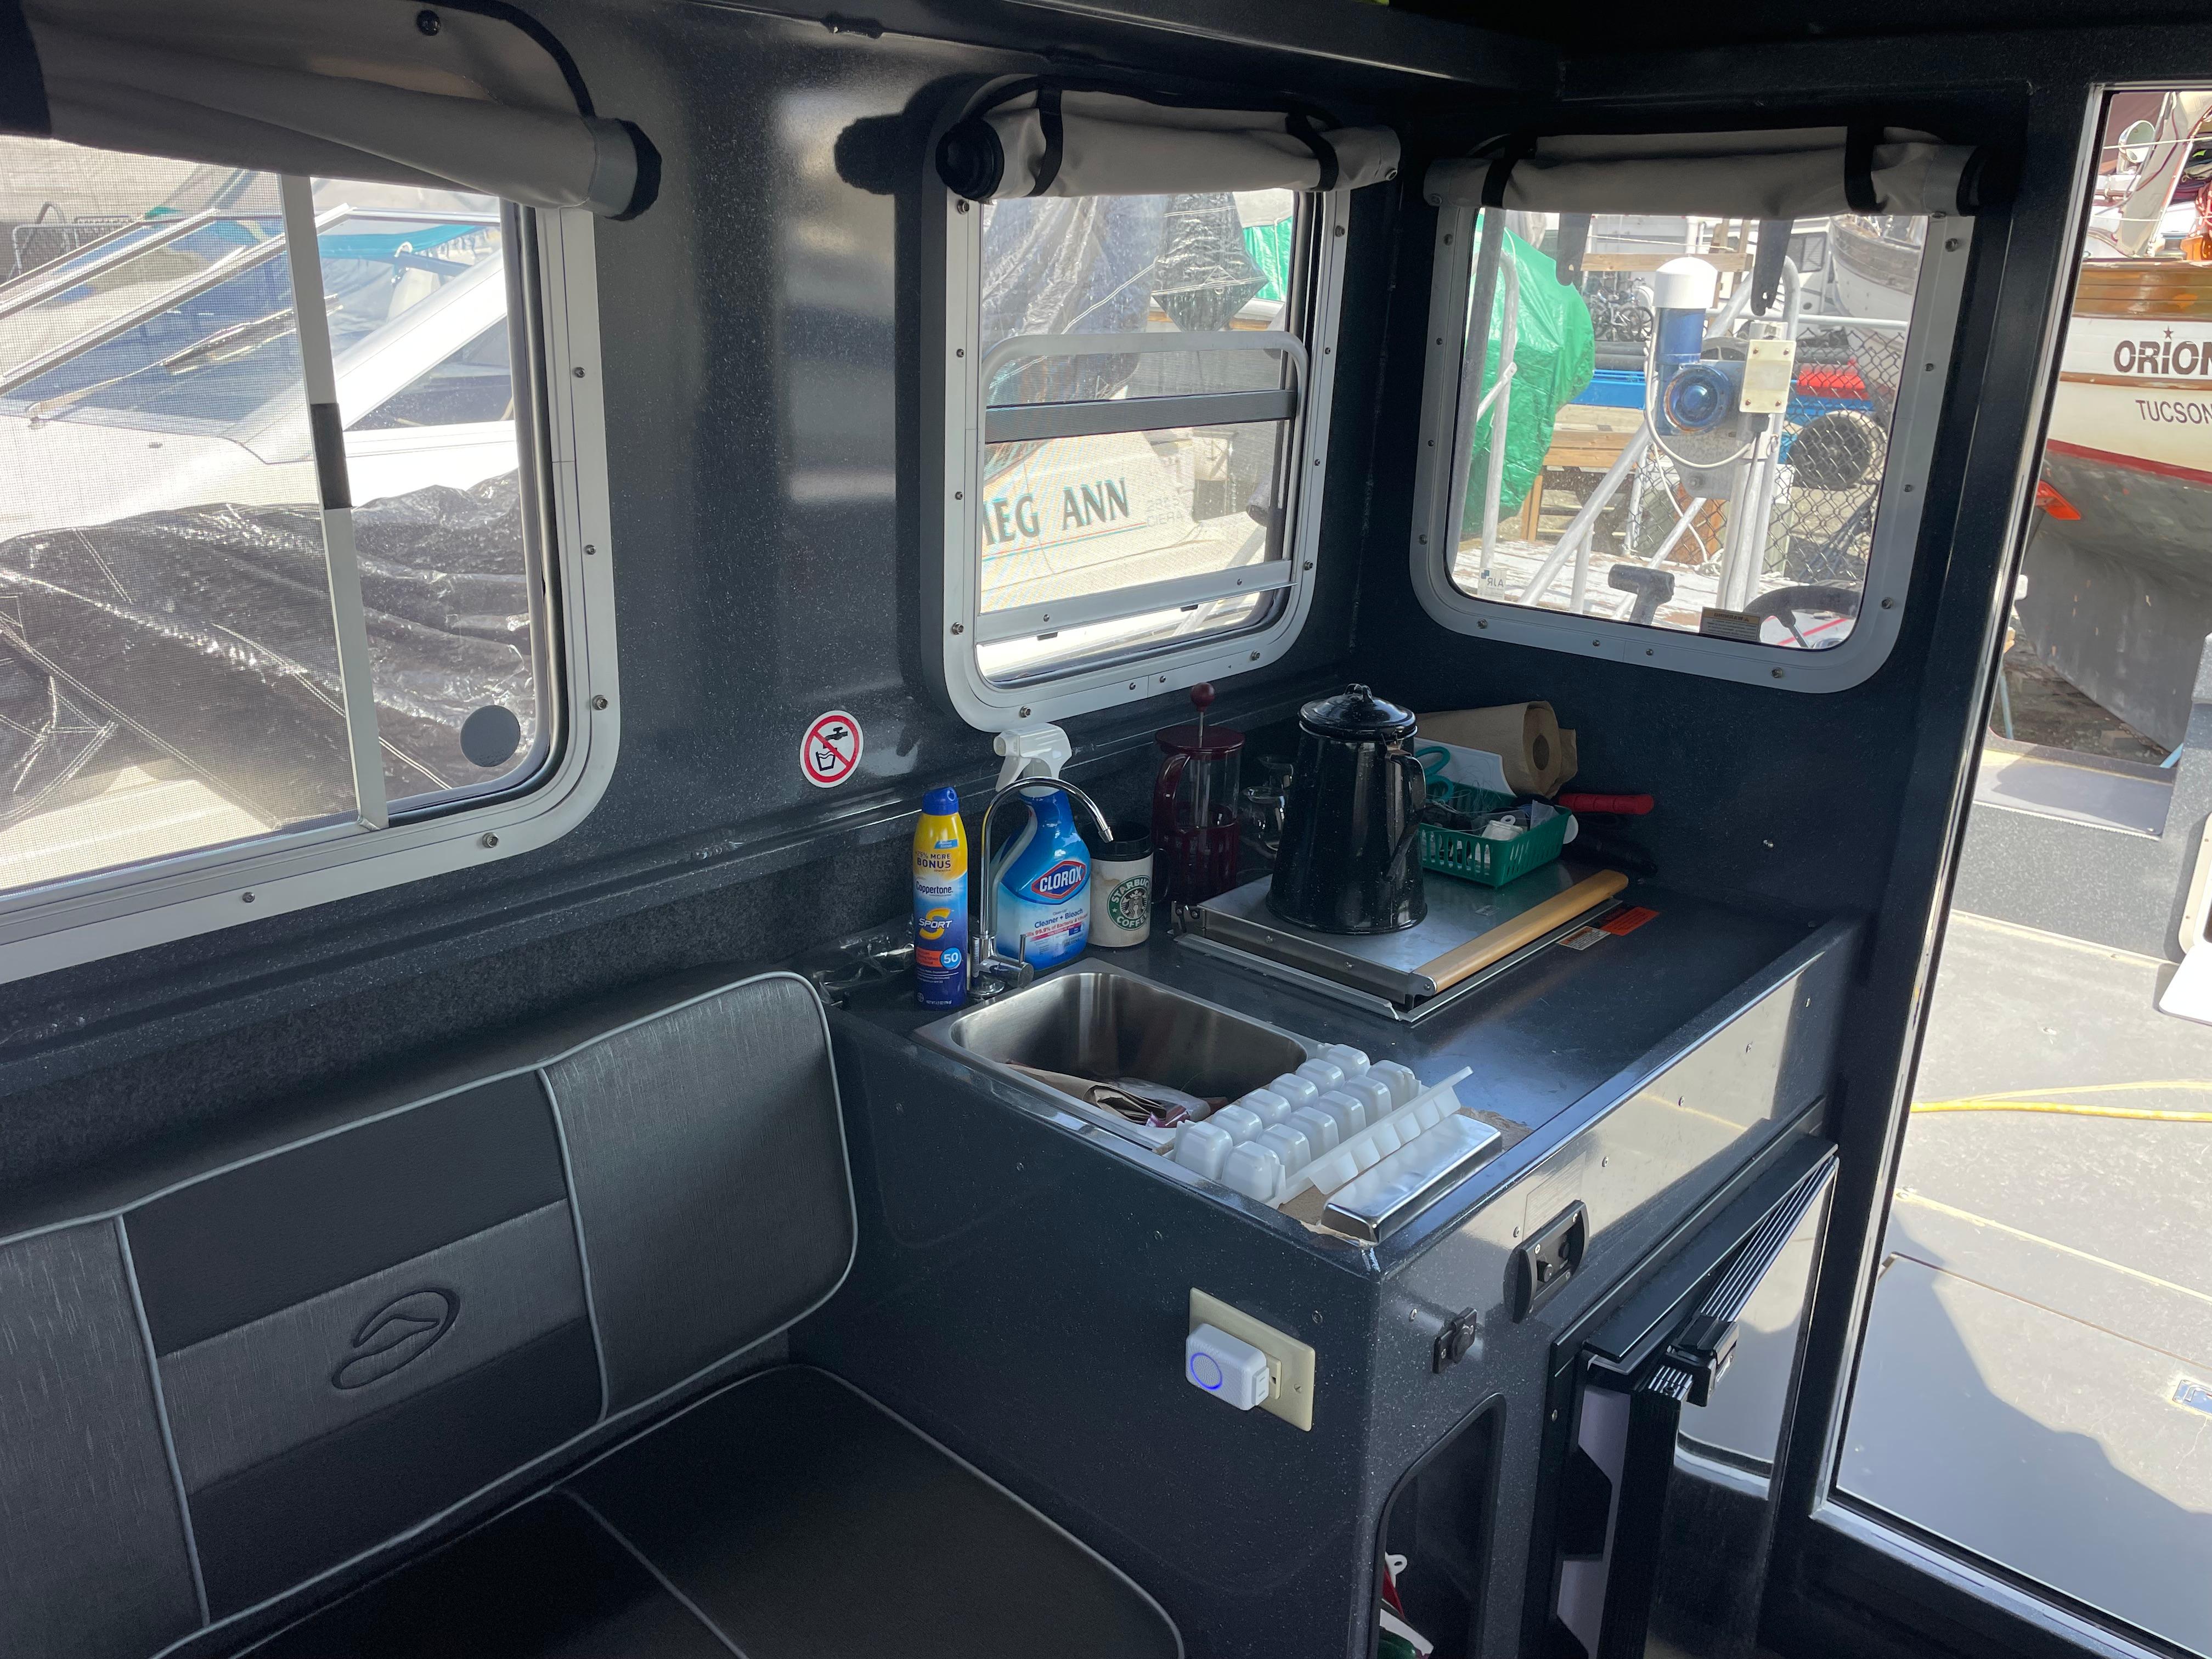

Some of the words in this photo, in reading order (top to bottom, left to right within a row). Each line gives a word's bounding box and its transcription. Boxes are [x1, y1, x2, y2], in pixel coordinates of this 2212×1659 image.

[2135, 399, 2212, 424] TUCSON
[1062, 477, 1129, 531] ANN
[917, 857, 951, 869] BONUS
[916, 881, 952, 894] Coppertone
[1040, 865, 1081, 892] CLOROX
[1111, 878, 1150, 904] STARBUC
[918, 918, 953, 929] SPORT
[1035, 917, 1058, 928] Cleaner
[1065, 909, 1083, 919] Bleach
[944, 952, 959, 964] 50
